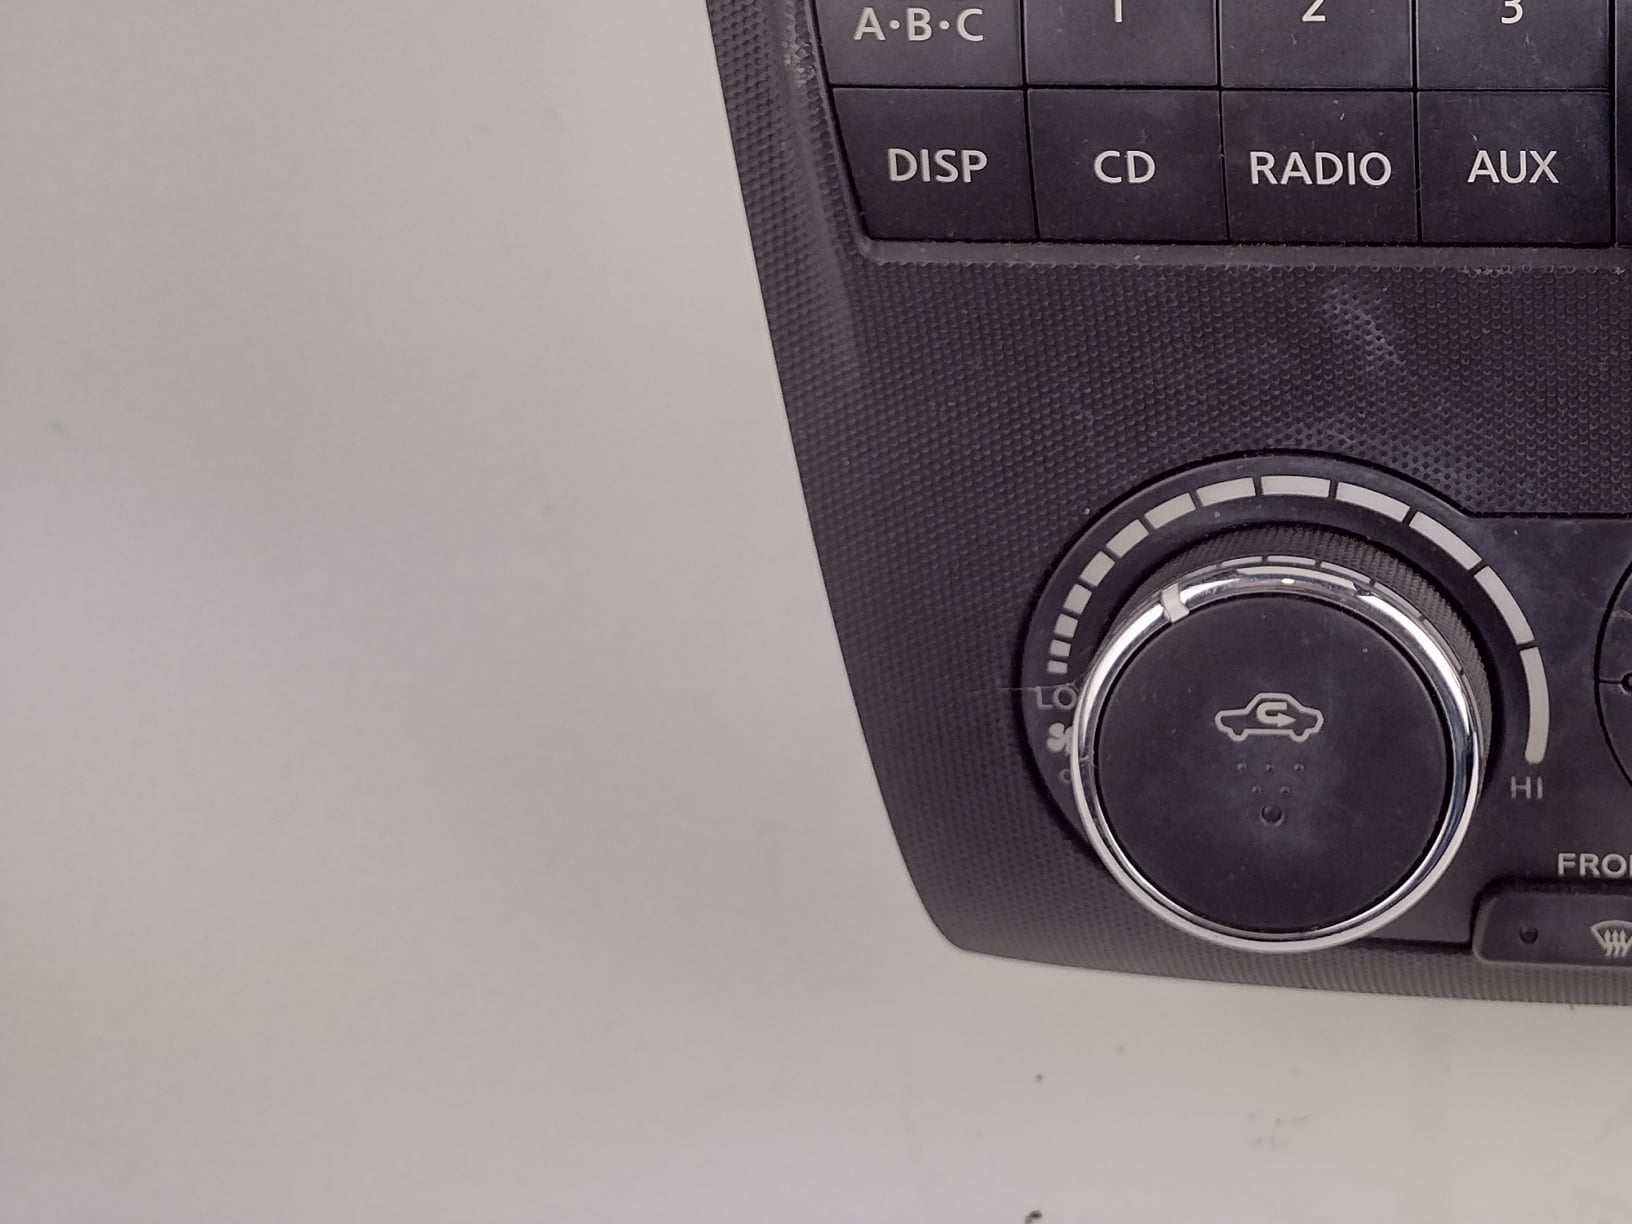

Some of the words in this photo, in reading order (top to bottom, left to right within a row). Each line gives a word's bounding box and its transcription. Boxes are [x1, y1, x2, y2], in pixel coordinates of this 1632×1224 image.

[887, 149, 988, 183] DISP
[1093, 151, 1156, 184] CD
[1249, 151, 1393, 186] RADIO
[1467, 151, 1560, 184] AUX
[1036, 685, 1078, 710] LO
[1511, 777, 1543, 800] HI
